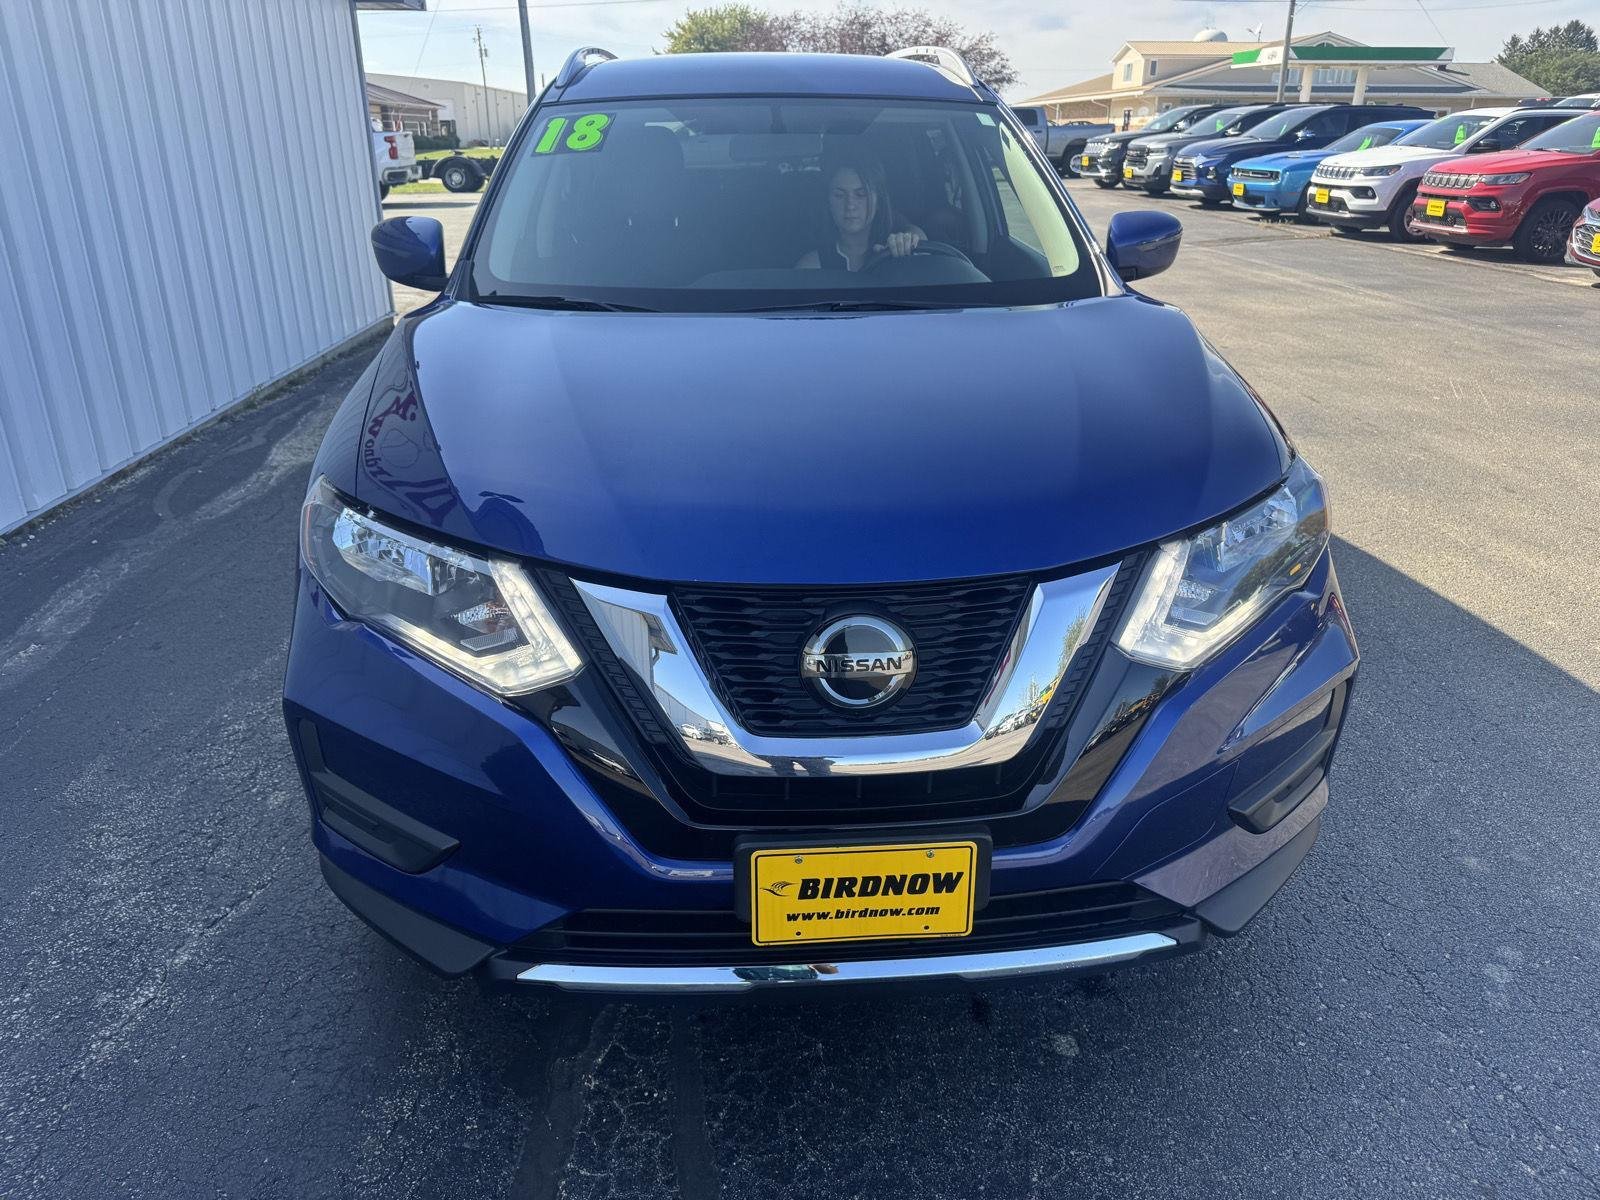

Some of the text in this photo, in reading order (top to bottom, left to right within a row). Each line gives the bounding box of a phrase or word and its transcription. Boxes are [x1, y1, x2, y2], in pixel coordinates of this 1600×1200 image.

[534, 113, 611, 153] 18
[815, 656, 903, 673] NISSAN
[797, 871, 964, 900] BIRDNOW
[786, 905, 940, 922] www.birdnow.com
